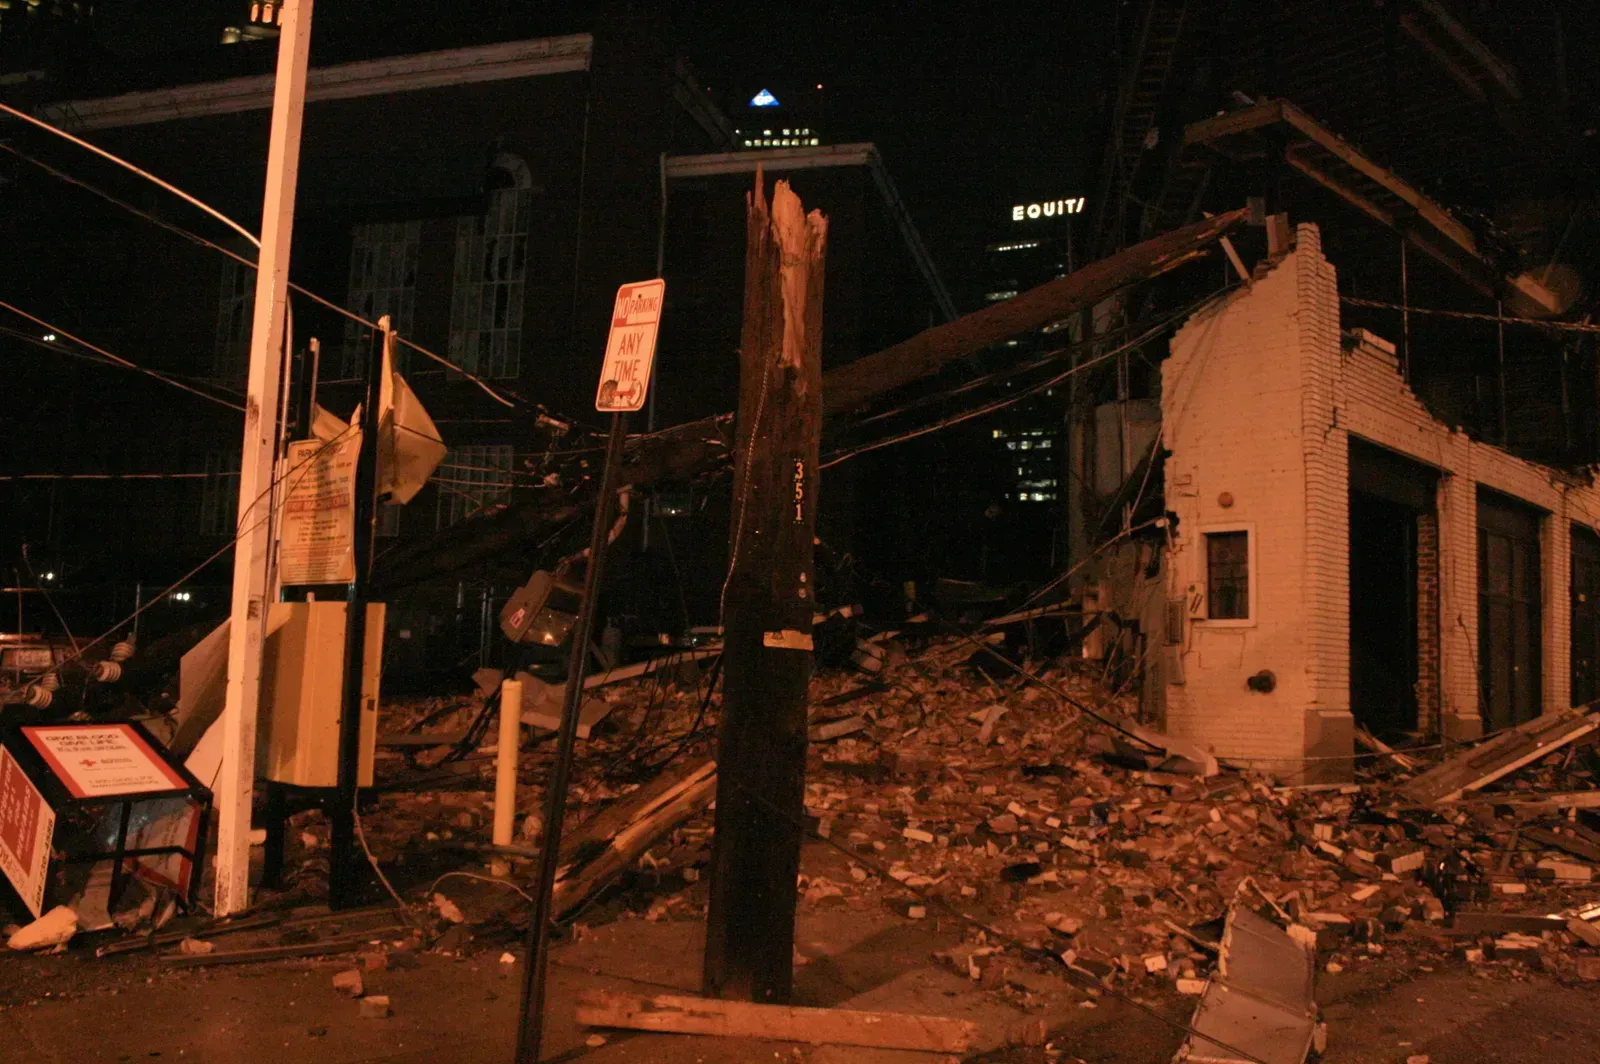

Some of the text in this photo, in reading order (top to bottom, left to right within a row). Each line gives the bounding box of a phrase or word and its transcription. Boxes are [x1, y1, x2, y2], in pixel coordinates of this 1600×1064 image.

[616, 296, 659, 319] NO PARKING
[617, 332, 644, 356] ANY
[613, 359, 641, 382] TIME
[794, 462, 804, 521] 351
